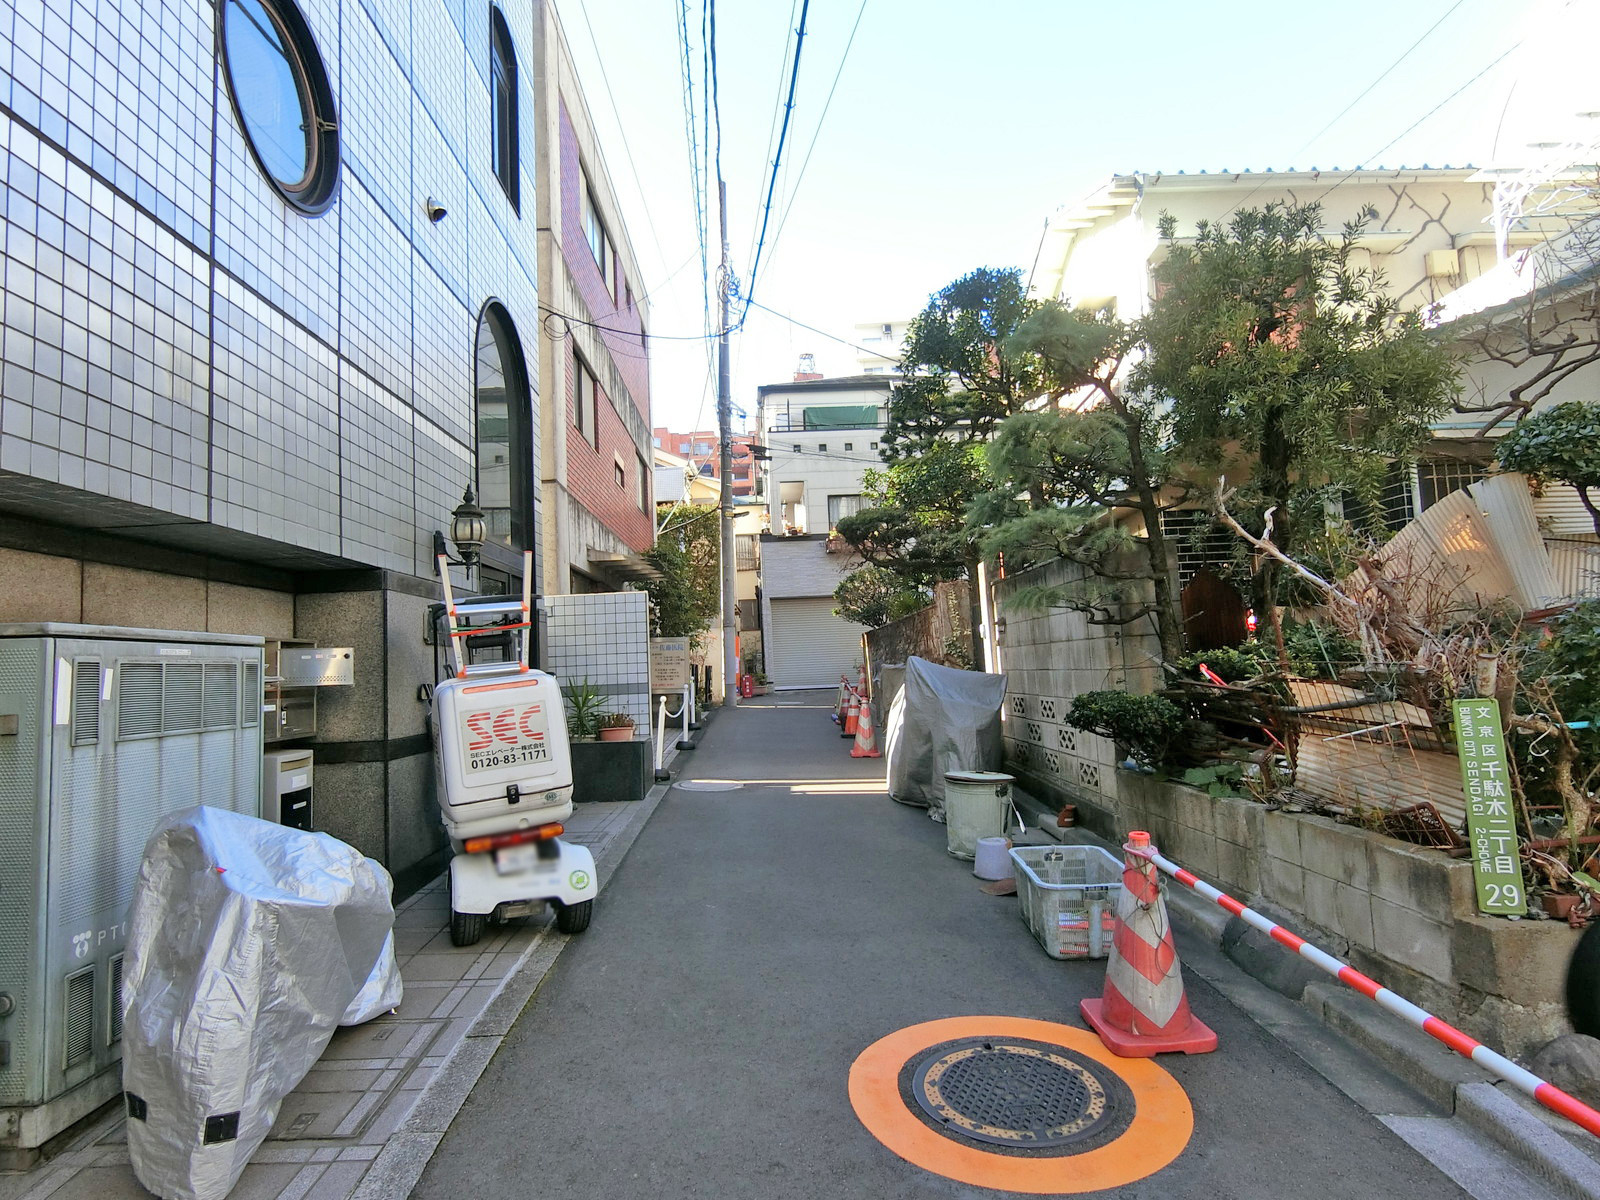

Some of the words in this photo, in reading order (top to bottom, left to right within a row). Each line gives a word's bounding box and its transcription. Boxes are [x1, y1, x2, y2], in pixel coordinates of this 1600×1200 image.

[467, 704, 544, 751] SEC
[1459, 706, 1474, 737] BUNKYO
[470, 742, 545, 759] SECエレベーター株式会社
[471, 748, 547, 770] 0120-83-1171
[1463, 740, 1477, 757] CITY
[1466, 760, 1485, 816] SENDAGI
[1475, 827, 1492, 873] 2-CHOME
[1484, 883, 1519, 907] 29
